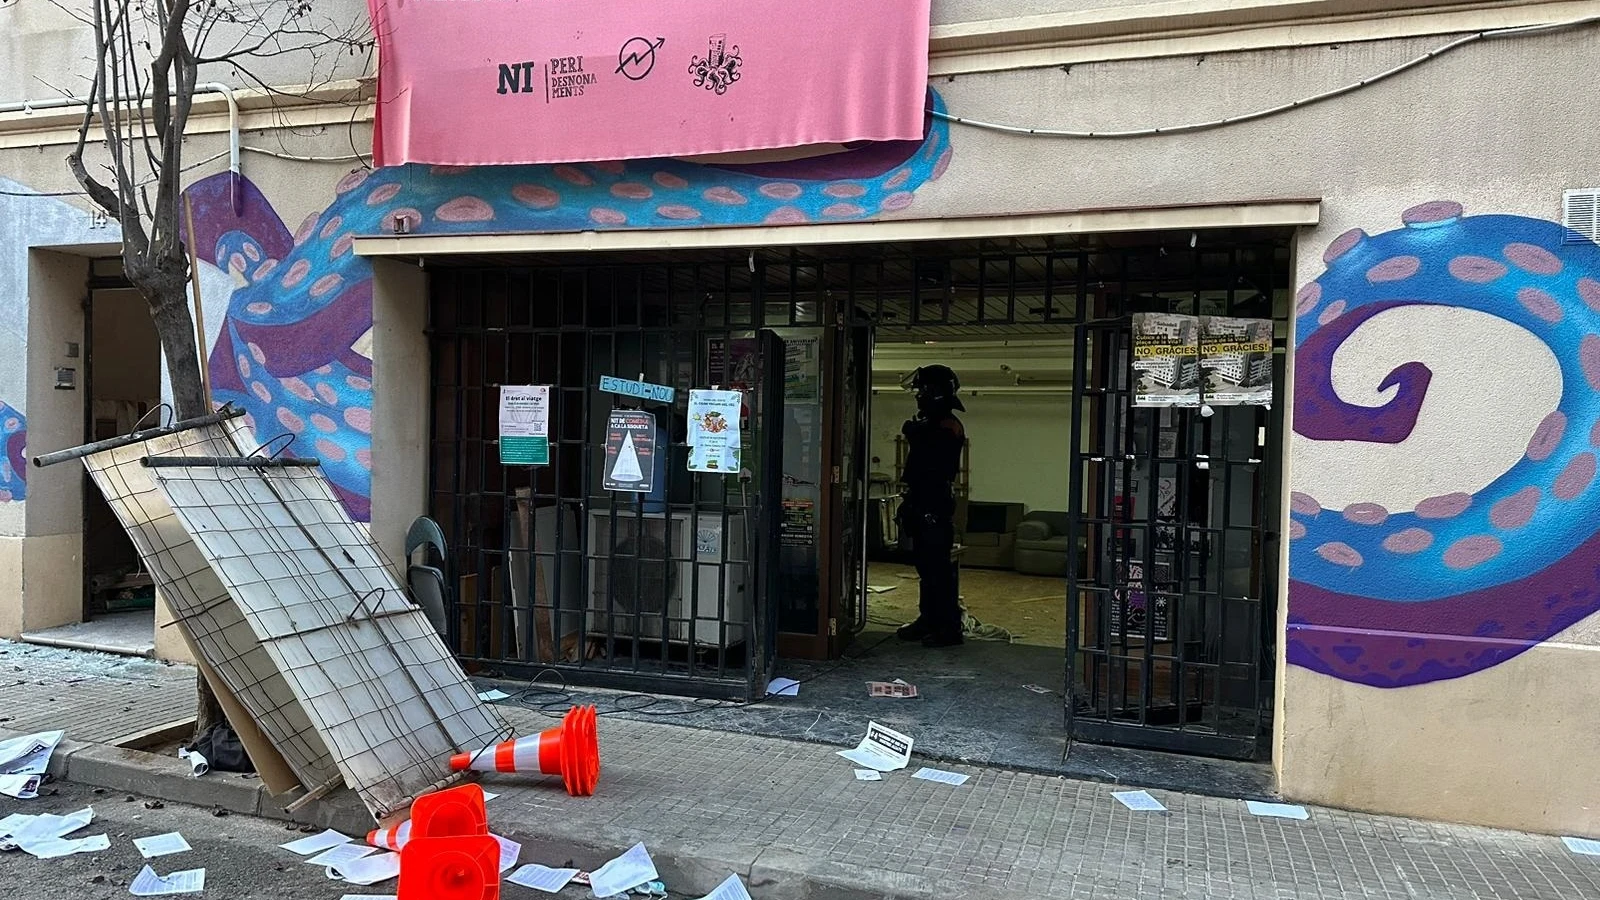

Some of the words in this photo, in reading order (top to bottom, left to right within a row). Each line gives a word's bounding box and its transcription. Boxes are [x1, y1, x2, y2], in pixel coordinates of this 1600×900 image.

[550, 56, 584, 75] PERI
[497, 62, 535, 95] NI
[551, 73, 598, 88] DESNONA
[551, 85, 585, 99] MENTS
[89, 209, 108, 230] 14
[1136, 347, 1153, 356] NO,
[1156, 343, 1200, 355] GRÀCIES!
[1202, 345, 1219, 354] NO,
[1223, 341, 1268, 352] GRÀCIES!
